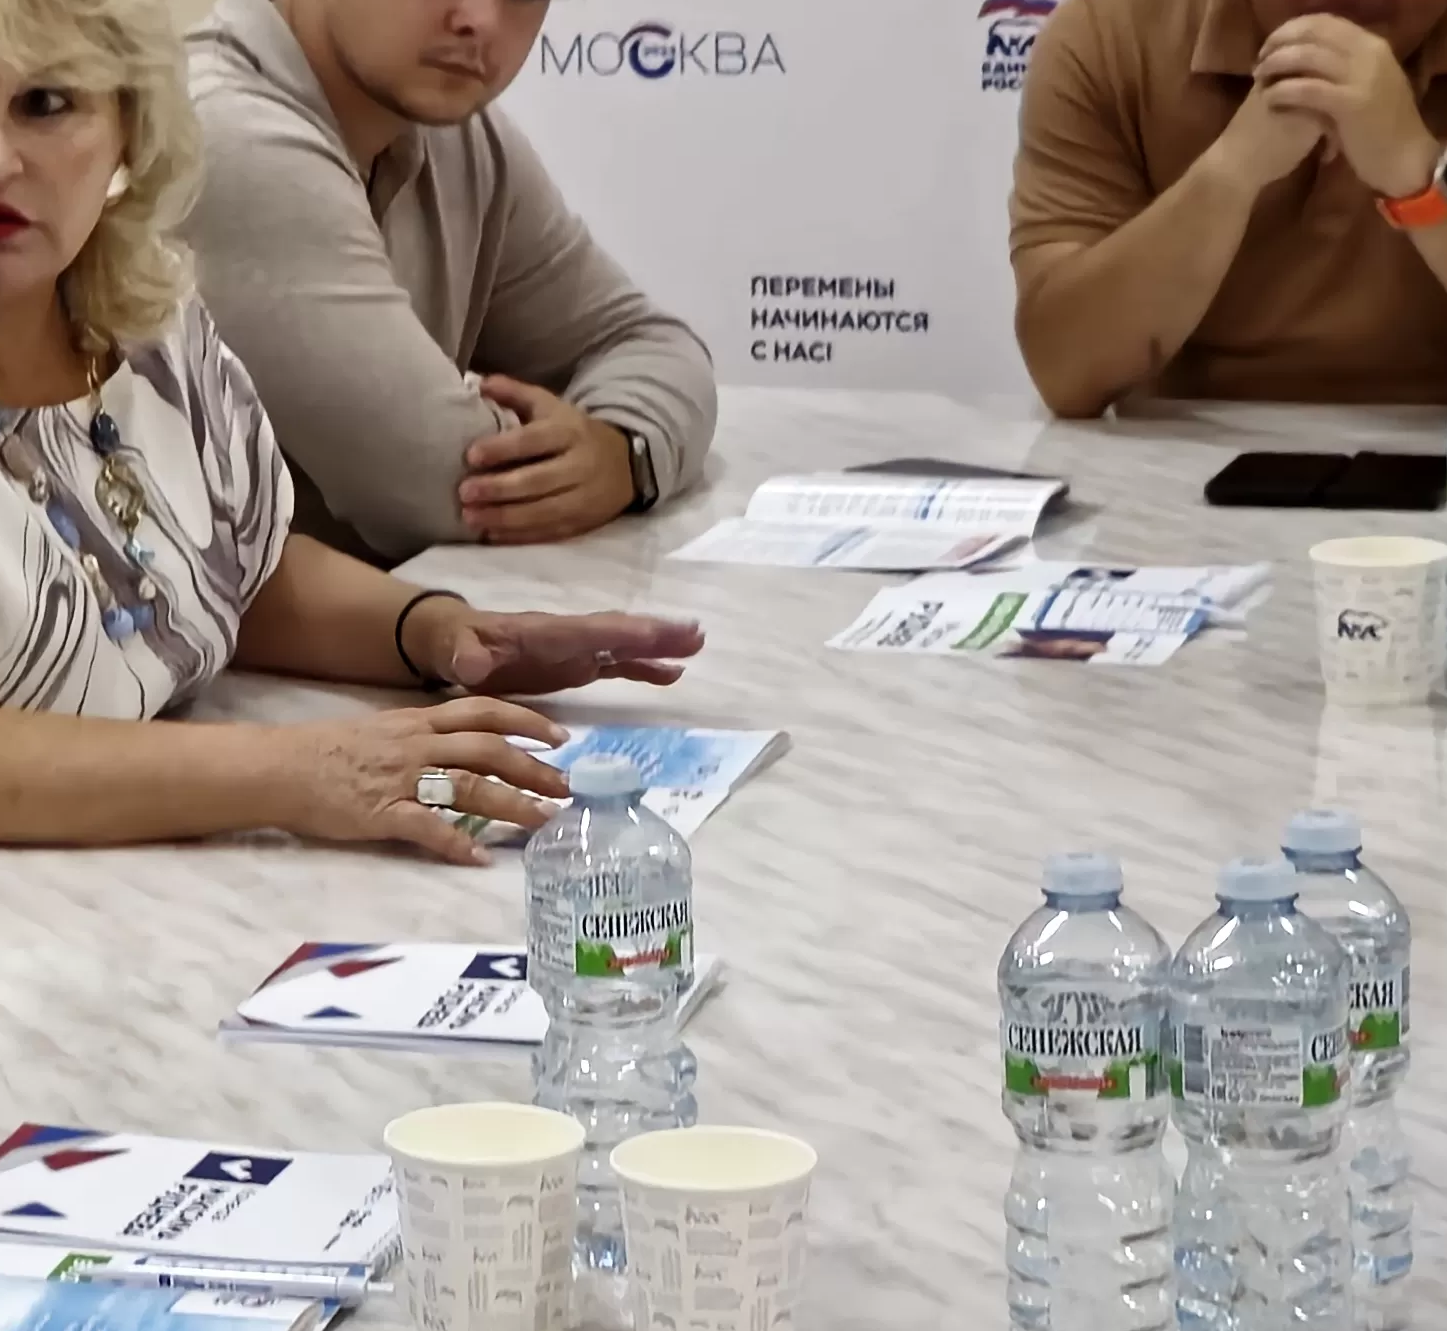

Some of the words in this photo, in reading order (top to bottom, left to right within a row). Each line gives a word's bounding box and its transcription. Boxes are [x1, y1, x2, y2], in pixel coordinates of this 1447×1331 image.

[540, 22, 787, 79] МОСКВА
[750, 274, 895, 301] ПЕРЕМЕНЫ
[750, 308, 930, 334] НАЧИНАЮТСЯ
[750, 339, 768, 362] С
[772, 338, 834, 363] НАС!
